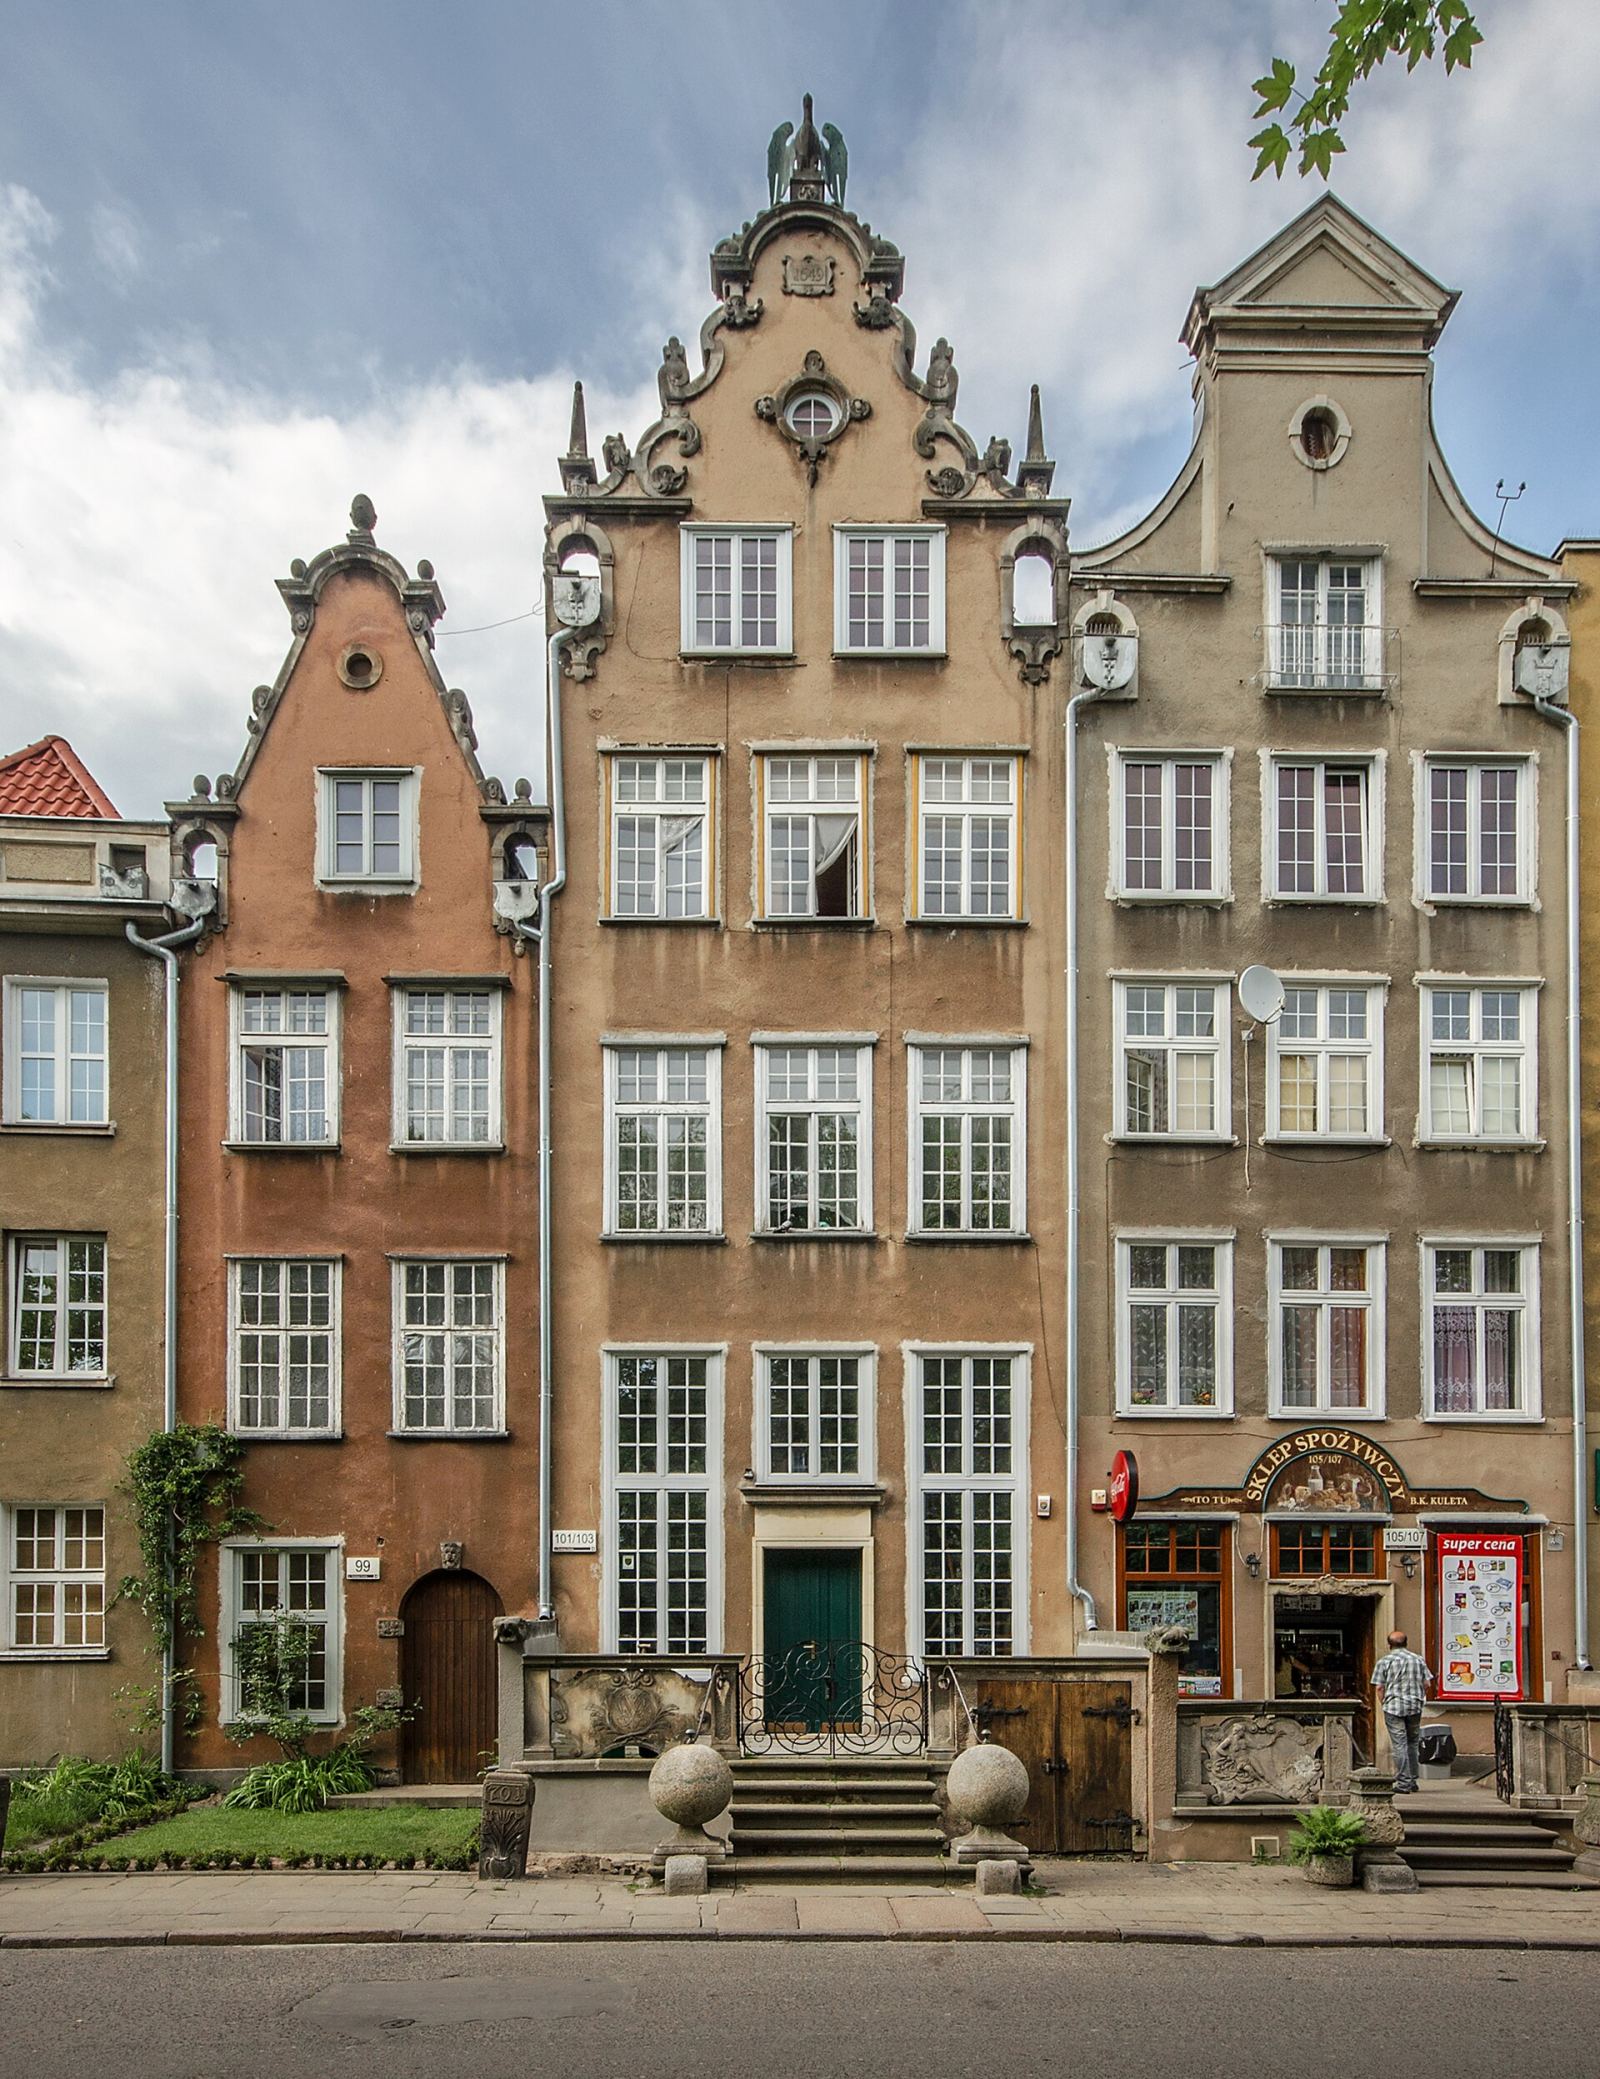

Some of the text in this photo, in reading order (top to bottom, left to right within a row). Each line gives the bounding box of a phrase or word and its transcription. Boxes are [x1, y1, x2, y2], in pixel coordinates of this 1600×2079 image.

[1308, 1455, 1342, 1464] 105/107
[1247, 1431, 1406, 1500] SKLEP SPOŻYWCZY
[1410, 1496, 1468, 1505] B.K. KULETA
[555, 1533, 594, 1544] 101/103
[1386, 1531, 1425, 1542] 105/107
[1443, 1539, 1516, 1552] super cena
[355, 1559, 371, 1573] 99
